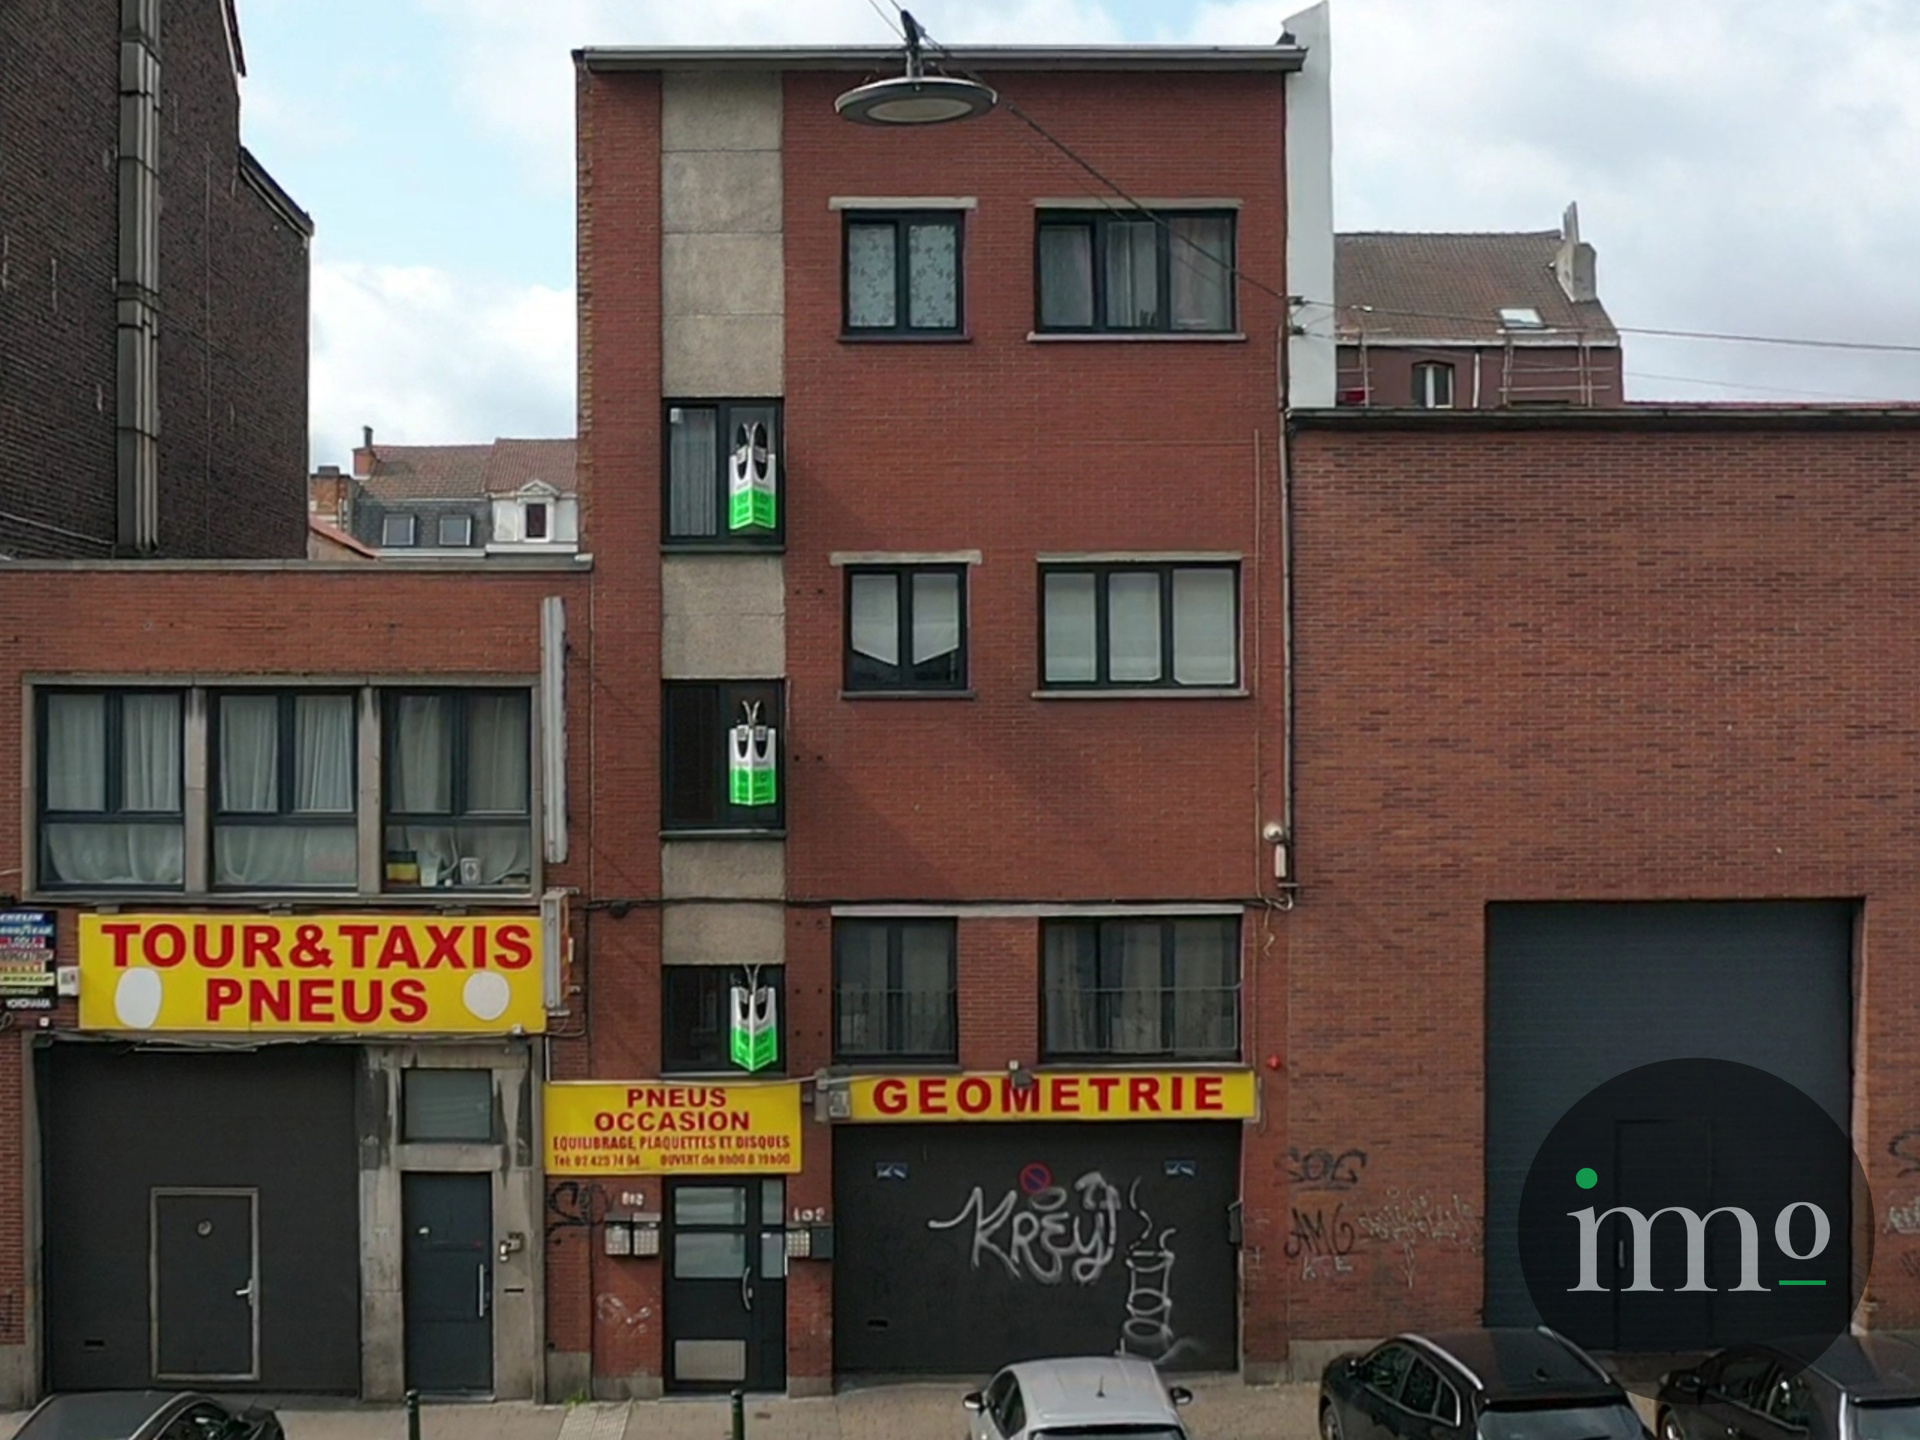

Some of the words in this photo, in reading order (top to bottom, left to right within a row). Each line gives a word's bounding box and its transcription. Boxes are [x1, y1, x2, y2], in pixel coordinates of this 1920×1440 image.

[101, 923, 533, 970] TOUR&TAXIS
[206, 978, 429, 1024] PNEUS
[626, 1087, 727, 1108] PNEUS
[872, 1076, 1224, 1114] GEOMETRIE
[594, 1110, 751, 1132] OCCASION
[639, 1135, 717, 1151] PLAQUETTES
[719, 1135, 732, 1149] ET
[735, 1135, 791, 1149] DISQUES
[660, 1153, 700, 1167] OUVERT
